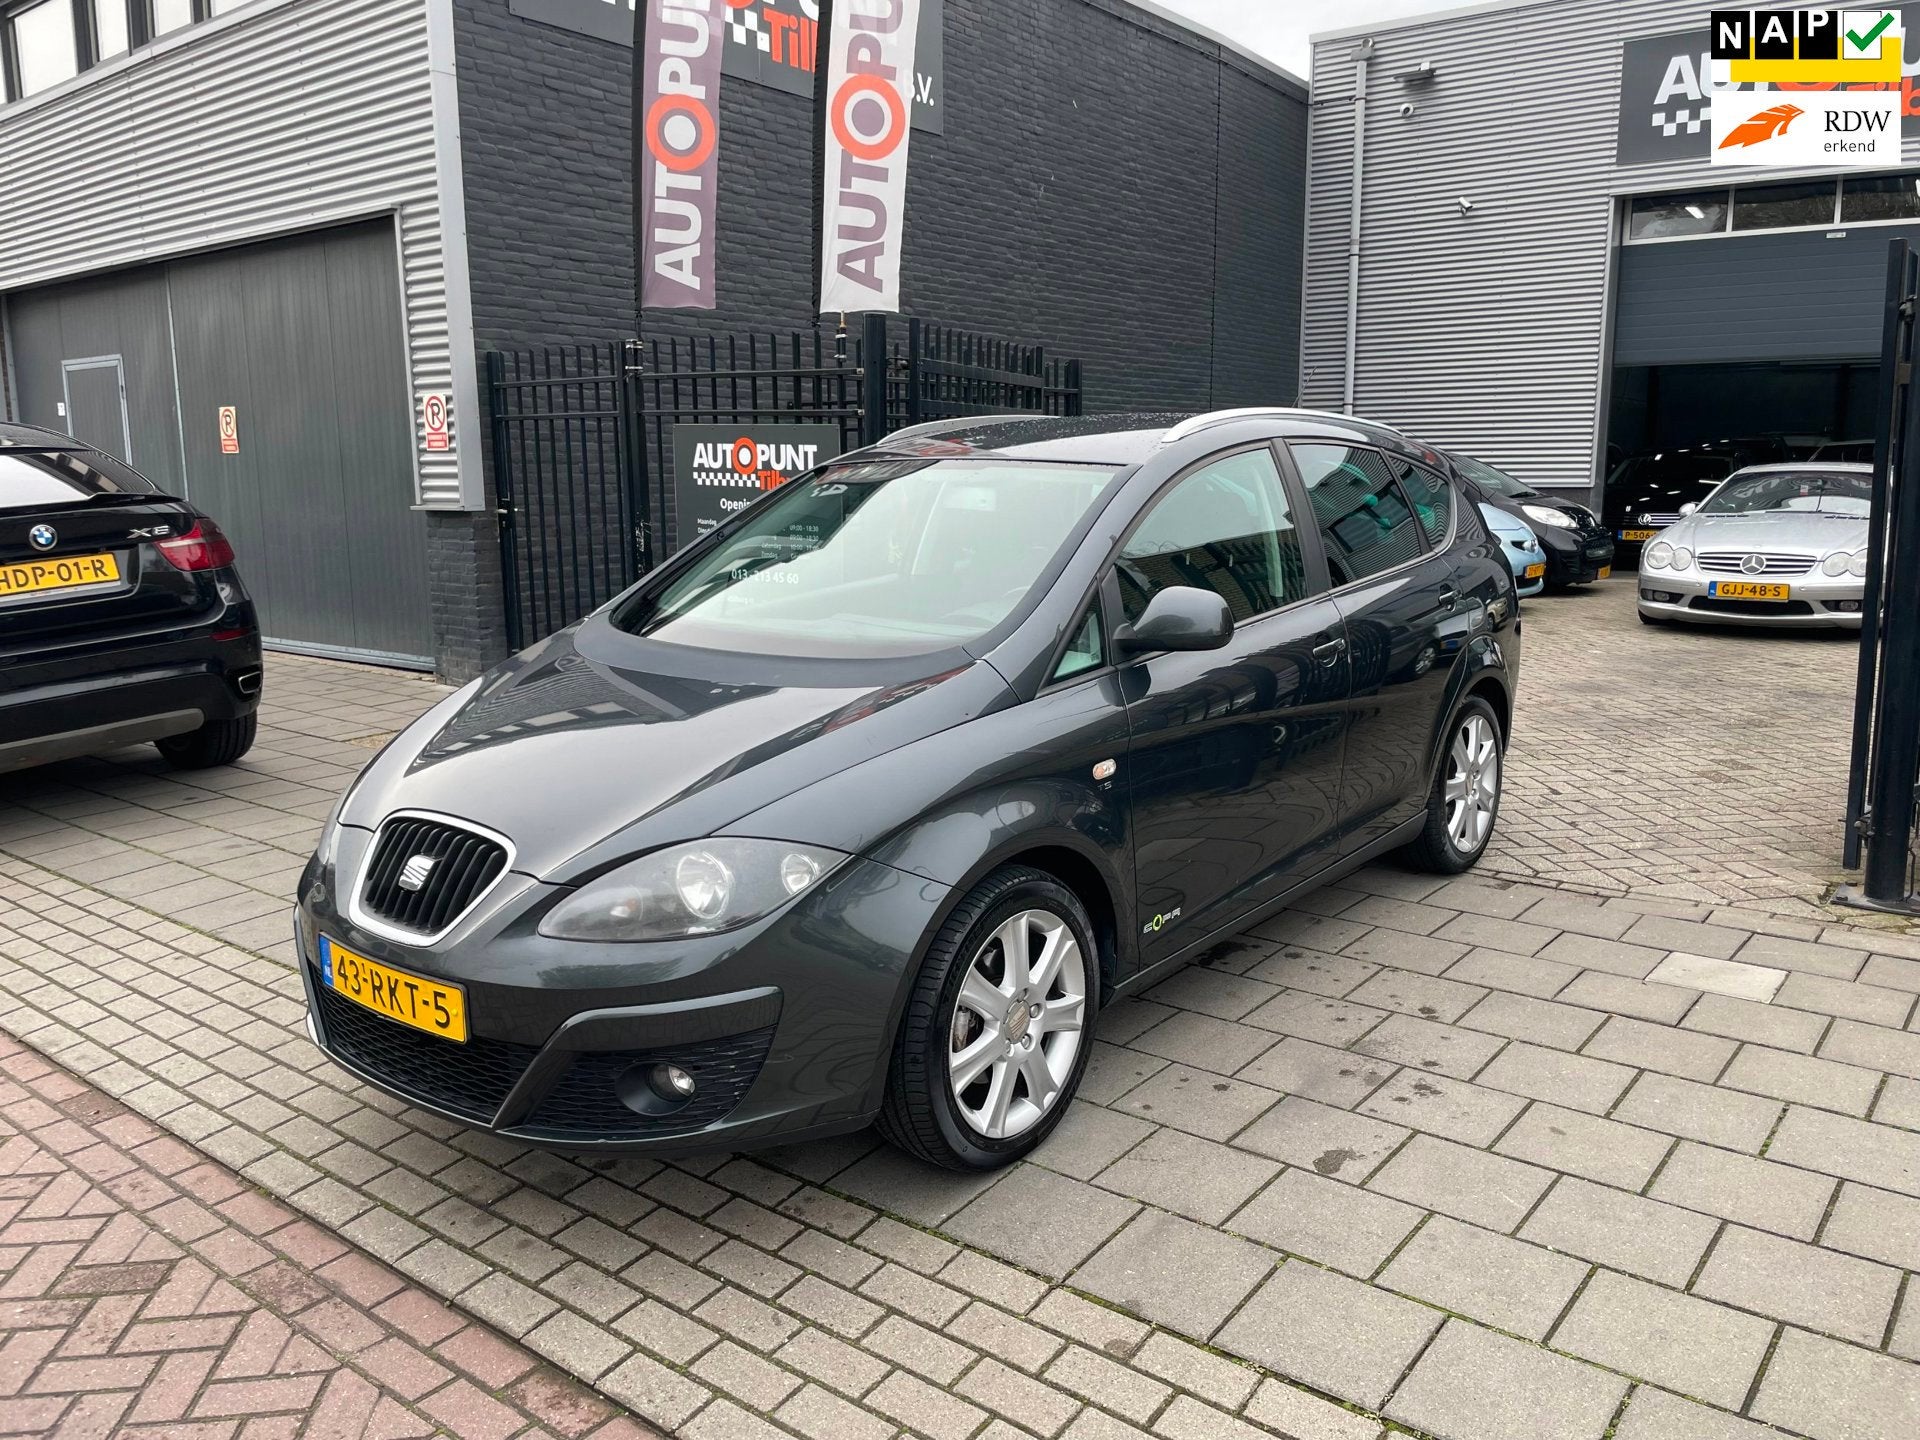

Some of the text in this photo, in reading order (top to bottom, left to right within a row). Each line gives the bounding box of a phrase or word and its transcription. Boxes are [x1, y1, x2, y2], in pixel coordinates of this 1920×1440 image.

[647, 0, 715, 290] AUTOPU
[693, 437, 817, 475] AUTOPUNT
[757, 470, 791, 491] Tilb
[1625, 531, 1657, 540] P-506-
[1721, 583, 1781, 597] GJJ-48-S
[337, 955, 451, 1029] 43-RKT-5
